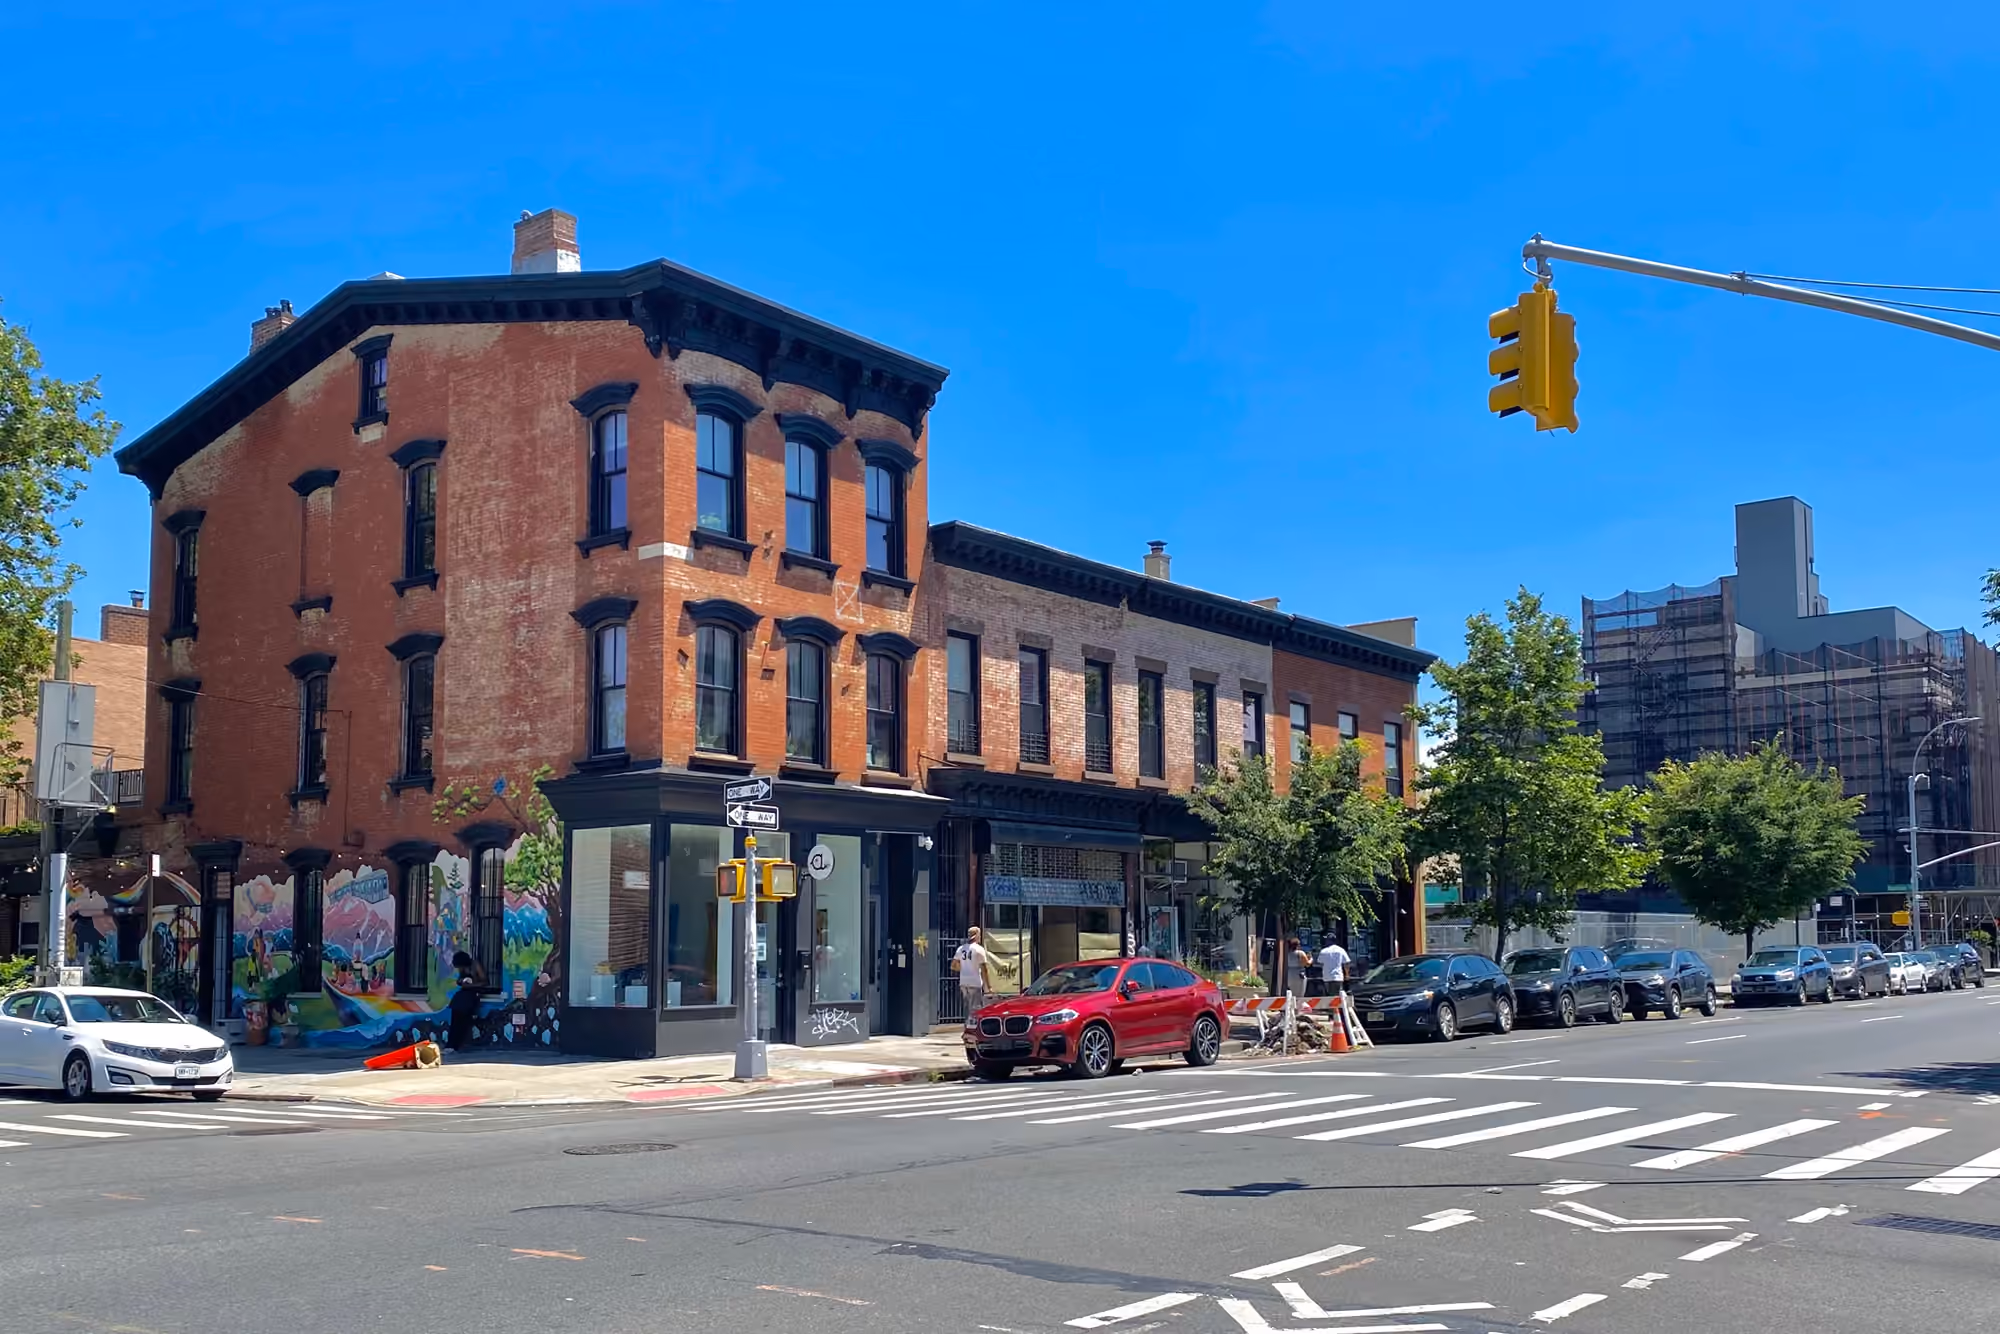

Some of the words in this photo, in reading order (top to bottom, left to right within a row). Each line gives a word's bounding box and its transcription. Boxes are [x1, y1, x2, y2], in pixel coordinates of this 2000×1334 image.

[728, 788, 742, 798] ONE
[750, 784, 765, 795] WAY
[734, 810, 750, 820] ONE
[758, 813, 774, 822] WAY
[961, 950, 973, 961] 34
